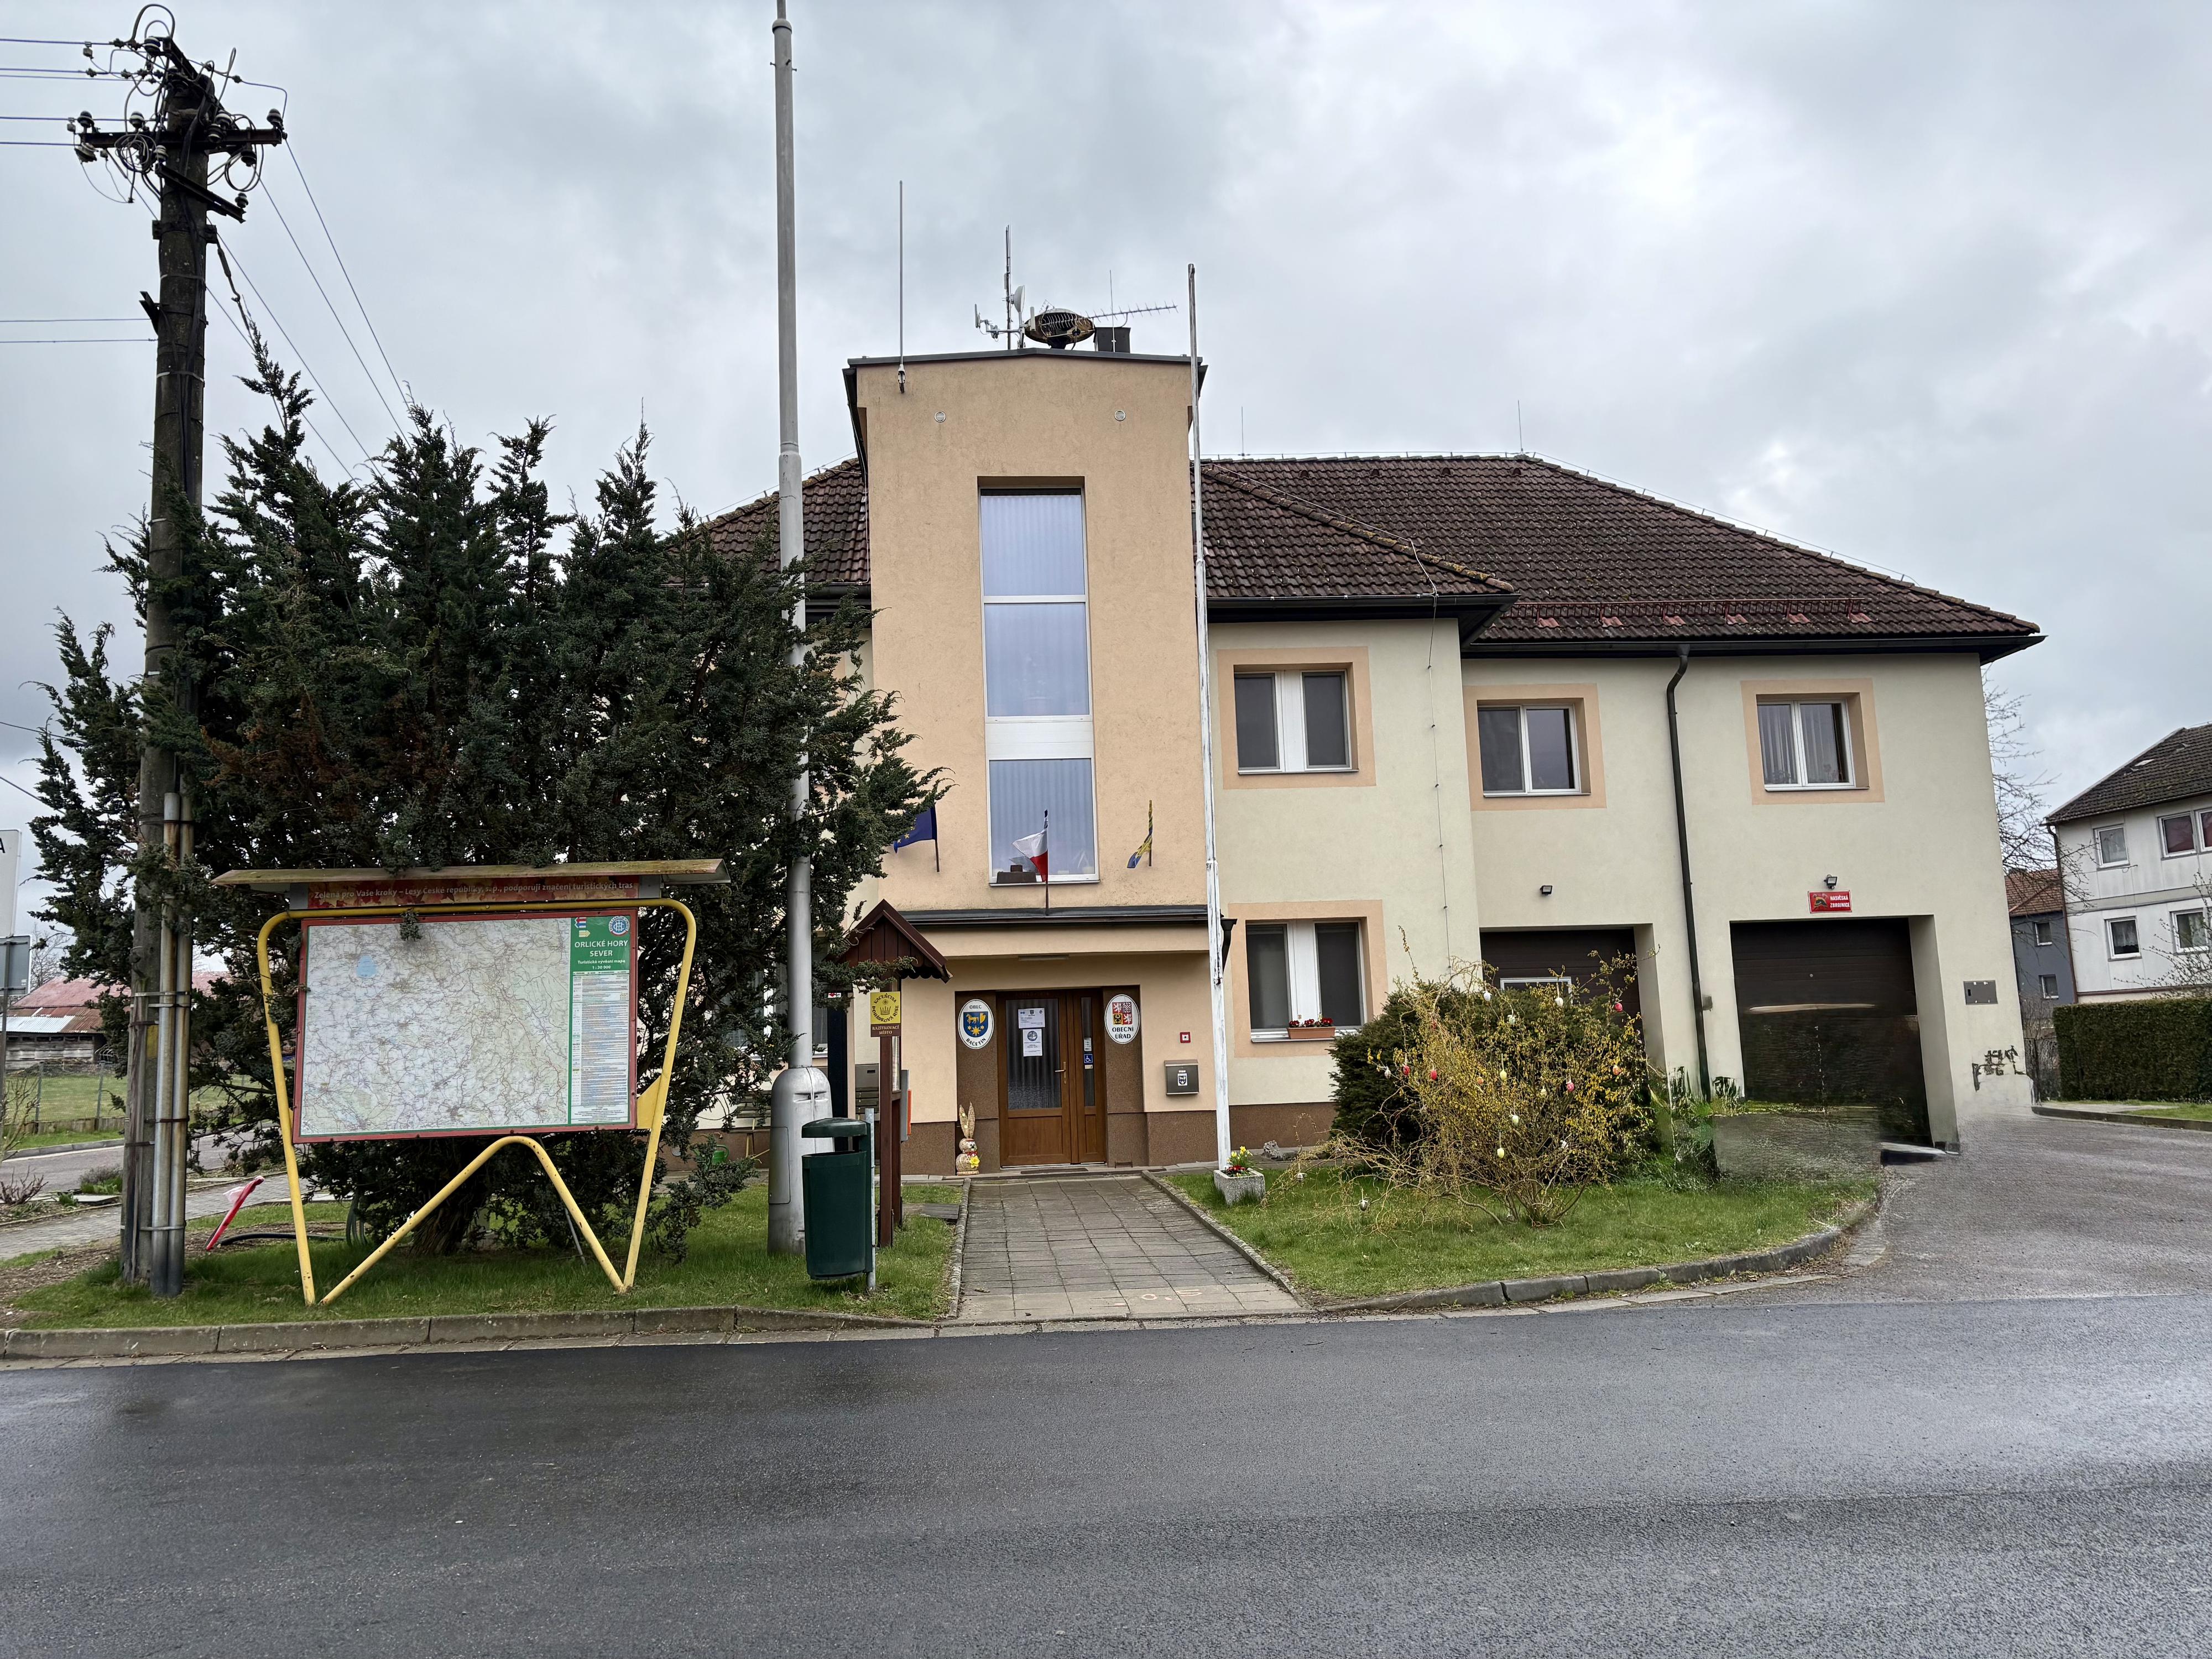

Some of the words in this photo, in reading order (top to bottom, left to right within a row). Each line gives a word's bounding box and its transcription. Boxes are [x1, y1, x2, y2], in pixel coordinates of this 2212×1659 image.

[405, 888, 421, 896] Lesy
[423, 886, 445, 894] České
[447, 885, 484, 894] republiky,
[504, 884, 541, 893] podporují
[573, 882, 617, 891] turistických
[575, 940, 606, 948] ORLICKÉ
